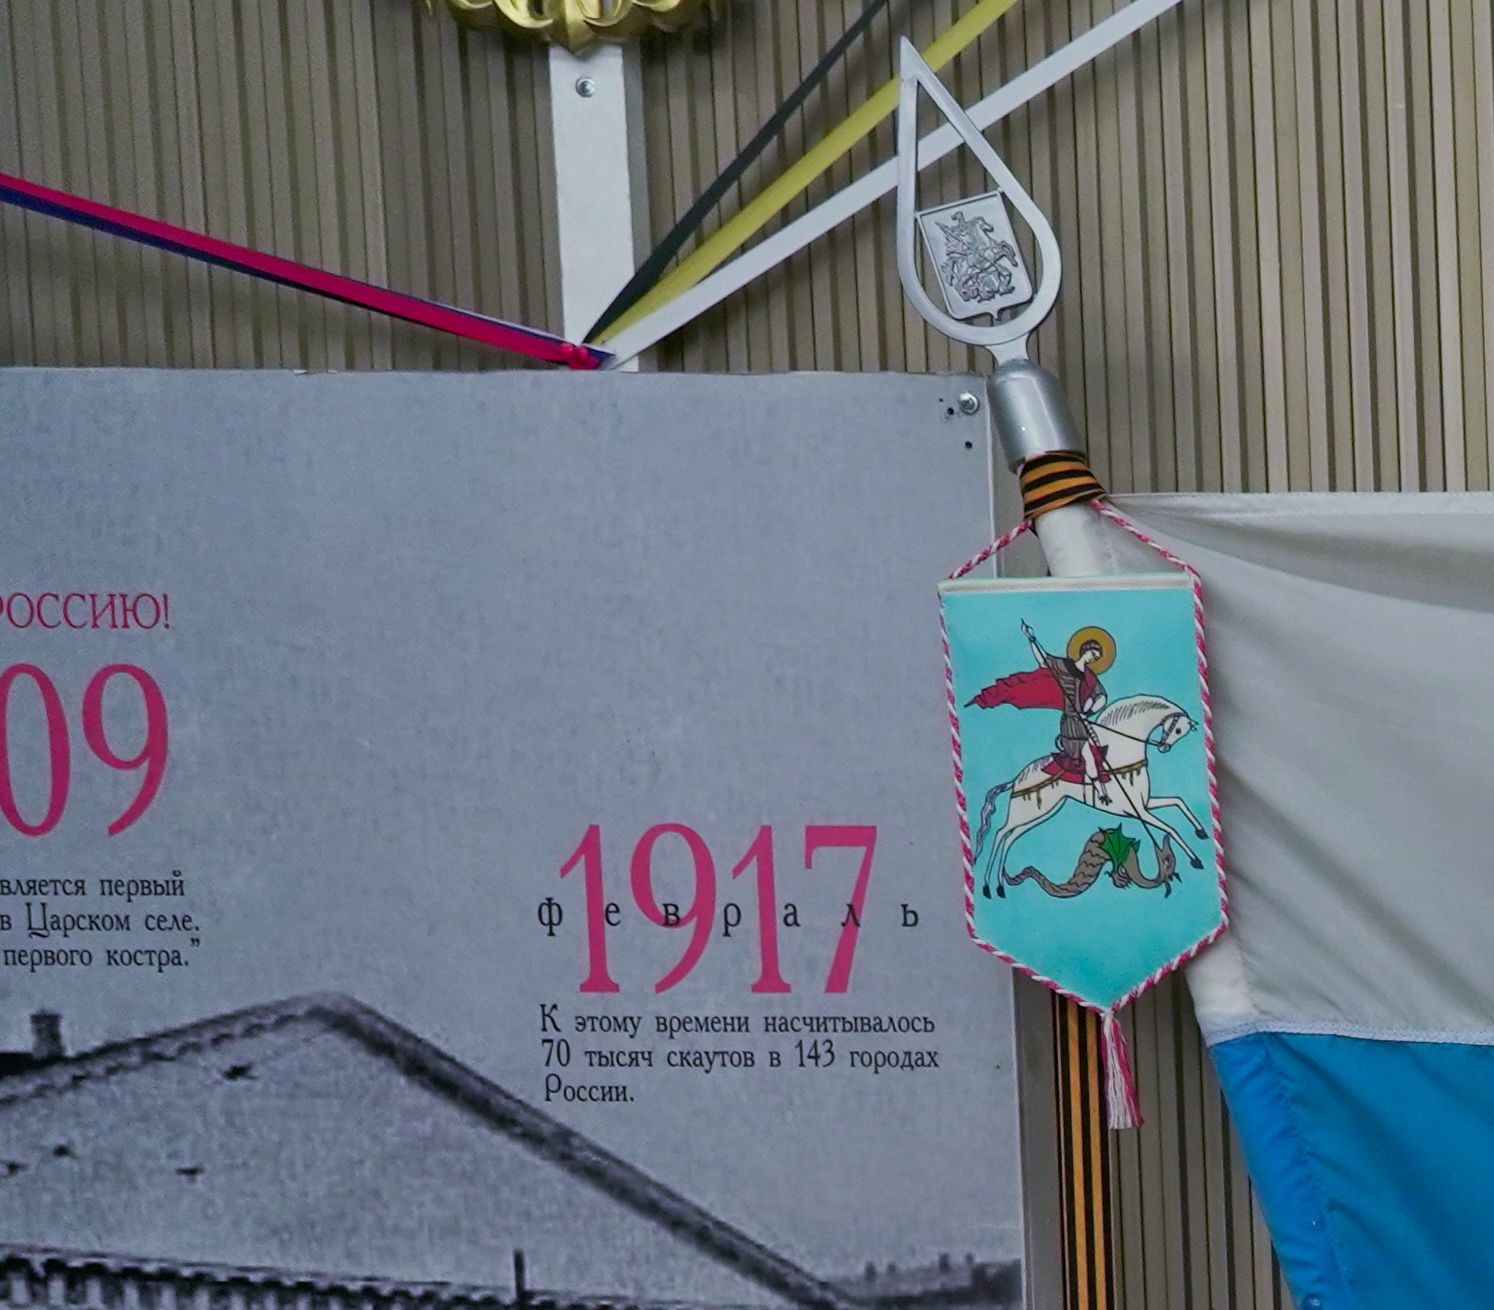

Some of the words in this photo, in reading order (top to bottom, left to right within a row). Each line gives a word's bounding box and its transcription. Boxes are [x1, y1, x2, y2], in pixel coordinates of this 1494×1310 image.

[0, 592, 170, 629] ОССИЮ!
[99, 870, 185, 903] первый
[0, 914, 12, 931] в
[26, 903, 131, 937] Царском
[144, 914, 199, 931] селе.
[559, 825, 877, 994] 1917
[3, 945, 93, 973] первого
[538, 1004, 562, 1033] К
[575, 1015, 642, 1039] этому
[655, 1016, 750, 1040] времени
[763, 1016, 935, 1040] насчитывалось
[541, 1041, 571, 1069] 70
[584, 1047, 653, 1069] тысяч
[667, 1047, 755, 1075] скаутов
[768, 1051, 781, 1067] в
[795, 1039, 835, 1067] 143
[849, 1051, 939, 1074] городах
[545, 1073, 634, 1102] России.
